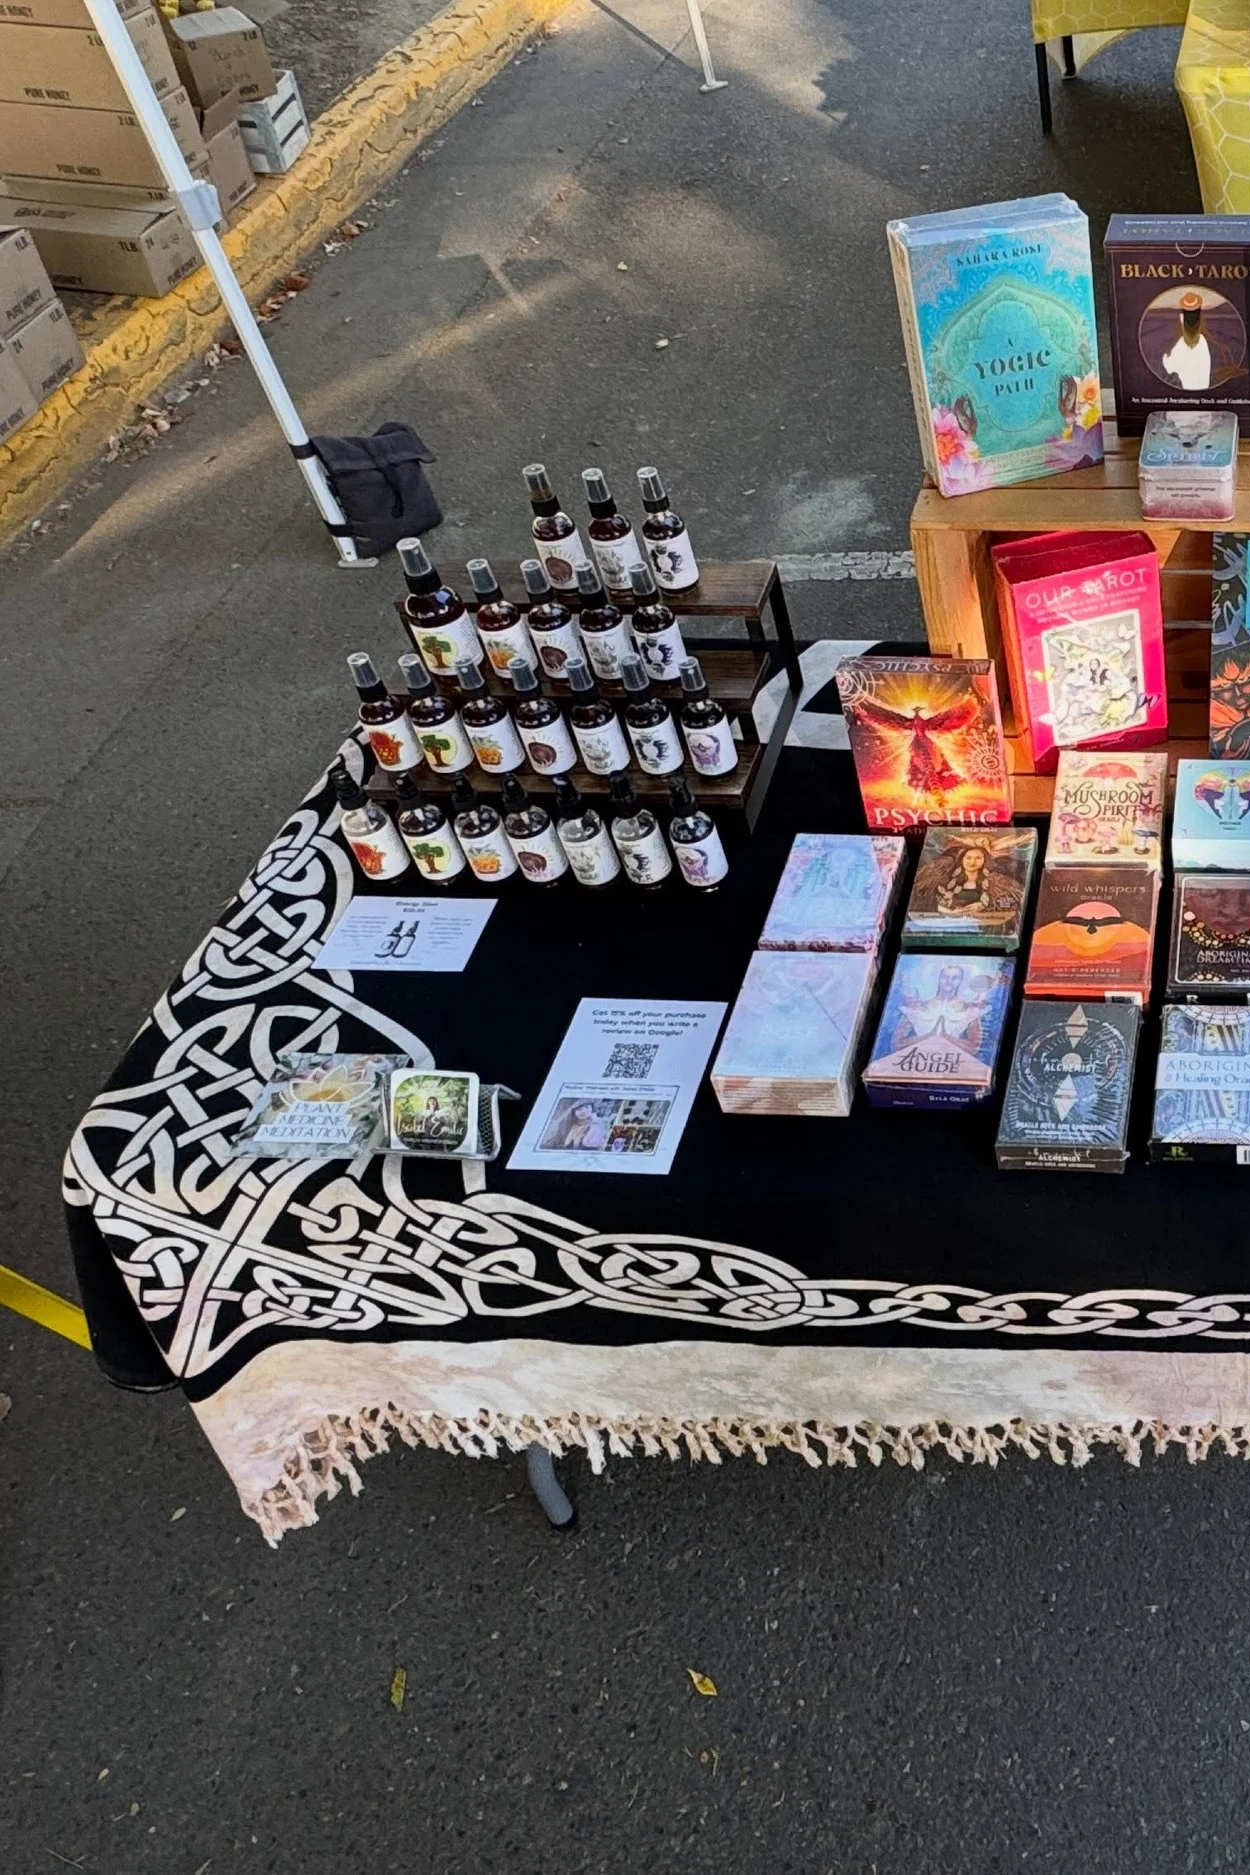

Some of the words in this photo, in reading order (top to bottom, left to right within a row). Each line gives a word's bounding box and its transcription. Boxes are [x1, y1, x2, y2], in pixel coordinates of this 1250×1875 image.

[956, 251, 1007, 267] SAHARA
[1120, 264, 1184, 278] BLACK
[974, 350, 1052, 380] YOGIC
[995, 379, 1035, 397] PATH
[1026, 585, 1073, 609] OUR
[874, 662, 951, 673] PSYCHIC
[1064, 783, 1154, 805] MUSHROOM
[873, 807, 999, 827] PSYCHIC
[1050, 883, 1079, 893] wild
[1084, 884, 1146, 896] whispers
[648, 1029, 683, 1037] Google!
[893, 1047, 966, 1067] ANGEL
[900, 1061, 961, 1074] GUIDE
[1043, 1063, 1096, 1073] ALCHEMIST
[1175, 1073, 1222, 1086] Healing
[294, 1103, 342, 1114] PLANT
[279, 1114, 345, 1126] MEDICINE
[260, 1126, 350, 1138] MEDITATION
